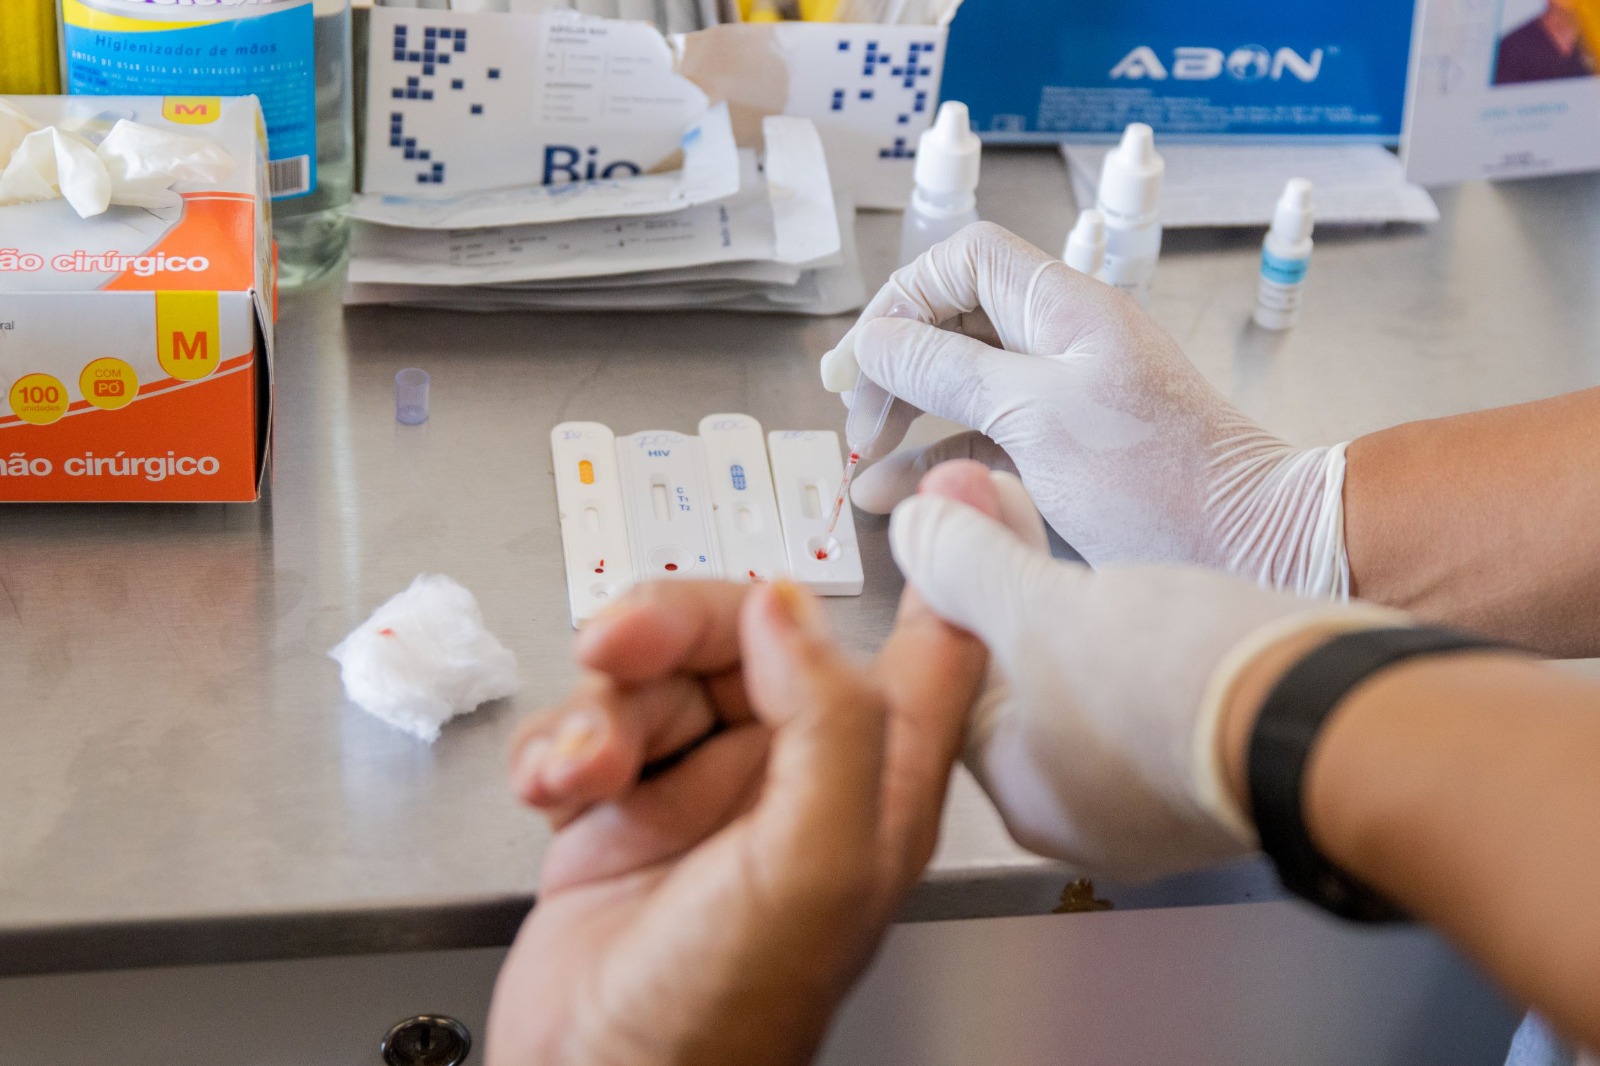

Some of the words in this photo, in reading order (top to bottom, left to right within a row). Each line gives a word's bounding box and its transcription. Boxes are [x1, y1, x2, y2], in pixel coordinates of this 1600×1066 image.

[96, 35, 200, 57] Higienizador
[209, 43, 227, 57] de
[235, 42, 278, 55] mãos
[1109, 45, 1323, 82] ABON
[174, 104, 207, 116] M
[53, 250, 209, 276] cirúrgico
[172, 331, 208, 360] M
[95, 369, 121, 378] COM
[18, 386, 59, 404] 100
[98, 380, 120, 394] PÓ
[21, 404, 61, 412] unidades
[648, 449, 671, 457] HIV
[64, 451, 220, 481] cirúrgico
[698, 555, 706, 563] S
